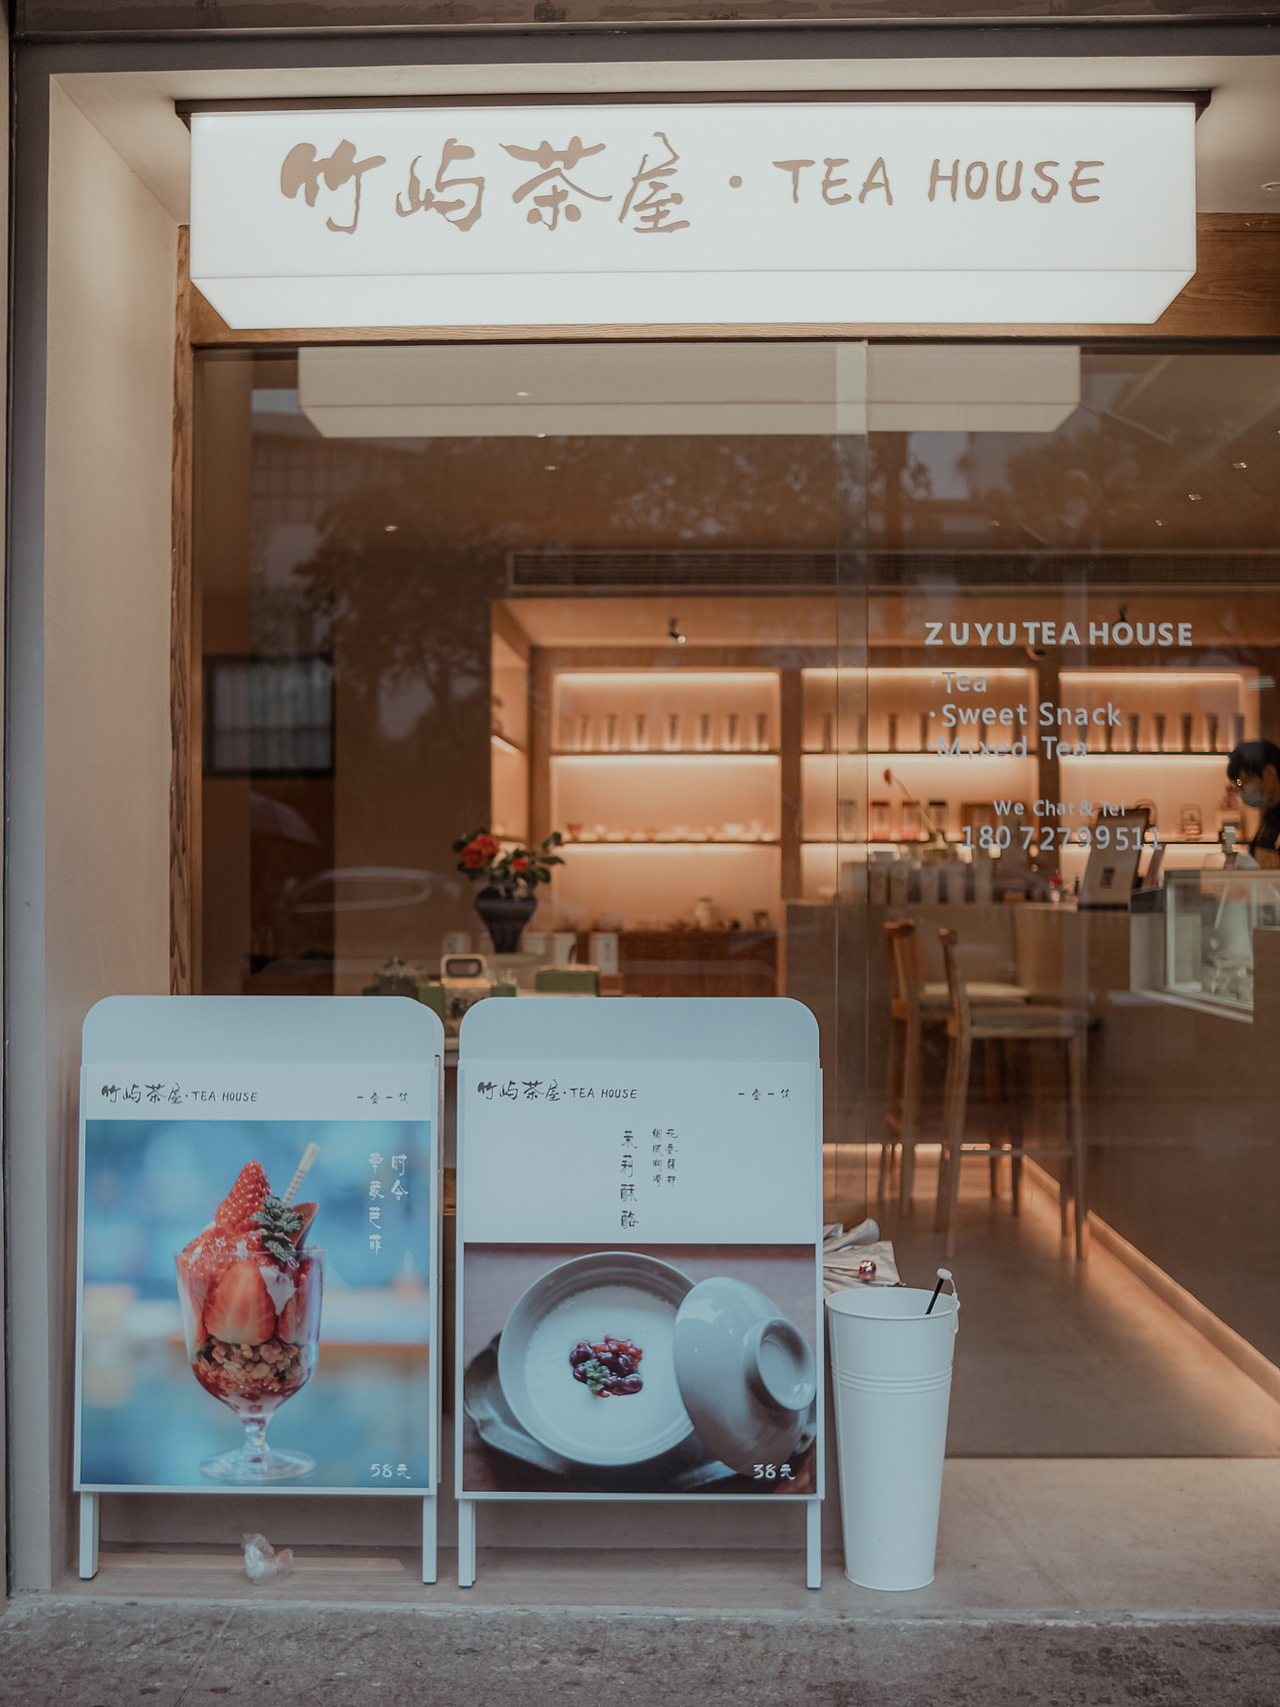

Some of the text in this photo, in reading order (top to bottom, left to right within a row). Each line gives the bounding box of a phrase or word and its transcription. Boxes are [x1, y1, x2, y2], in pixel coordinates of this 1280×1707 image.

[772, 157, 894, 207] TEA
[928, 159, 1105, 204] HOUSE
[924, 621, 1193, 647] ZUYU TEA HOUSE
[942, 671, 988, 694] Tea
[941, 701, 1122, 728] Sweet Snack
[936, 735, 1088, 760] Mixed Tea
[1100, 800, 1126, 817] Tel
[192, 1090, 217, 1102] TEA
[221, 1091, 258, 1103] HOUSE
[570, 1087, 595, 1099] TEA
[601, 1088, 638, 1100] HOUSE
[391, 1152, 410, 1202] 时令
